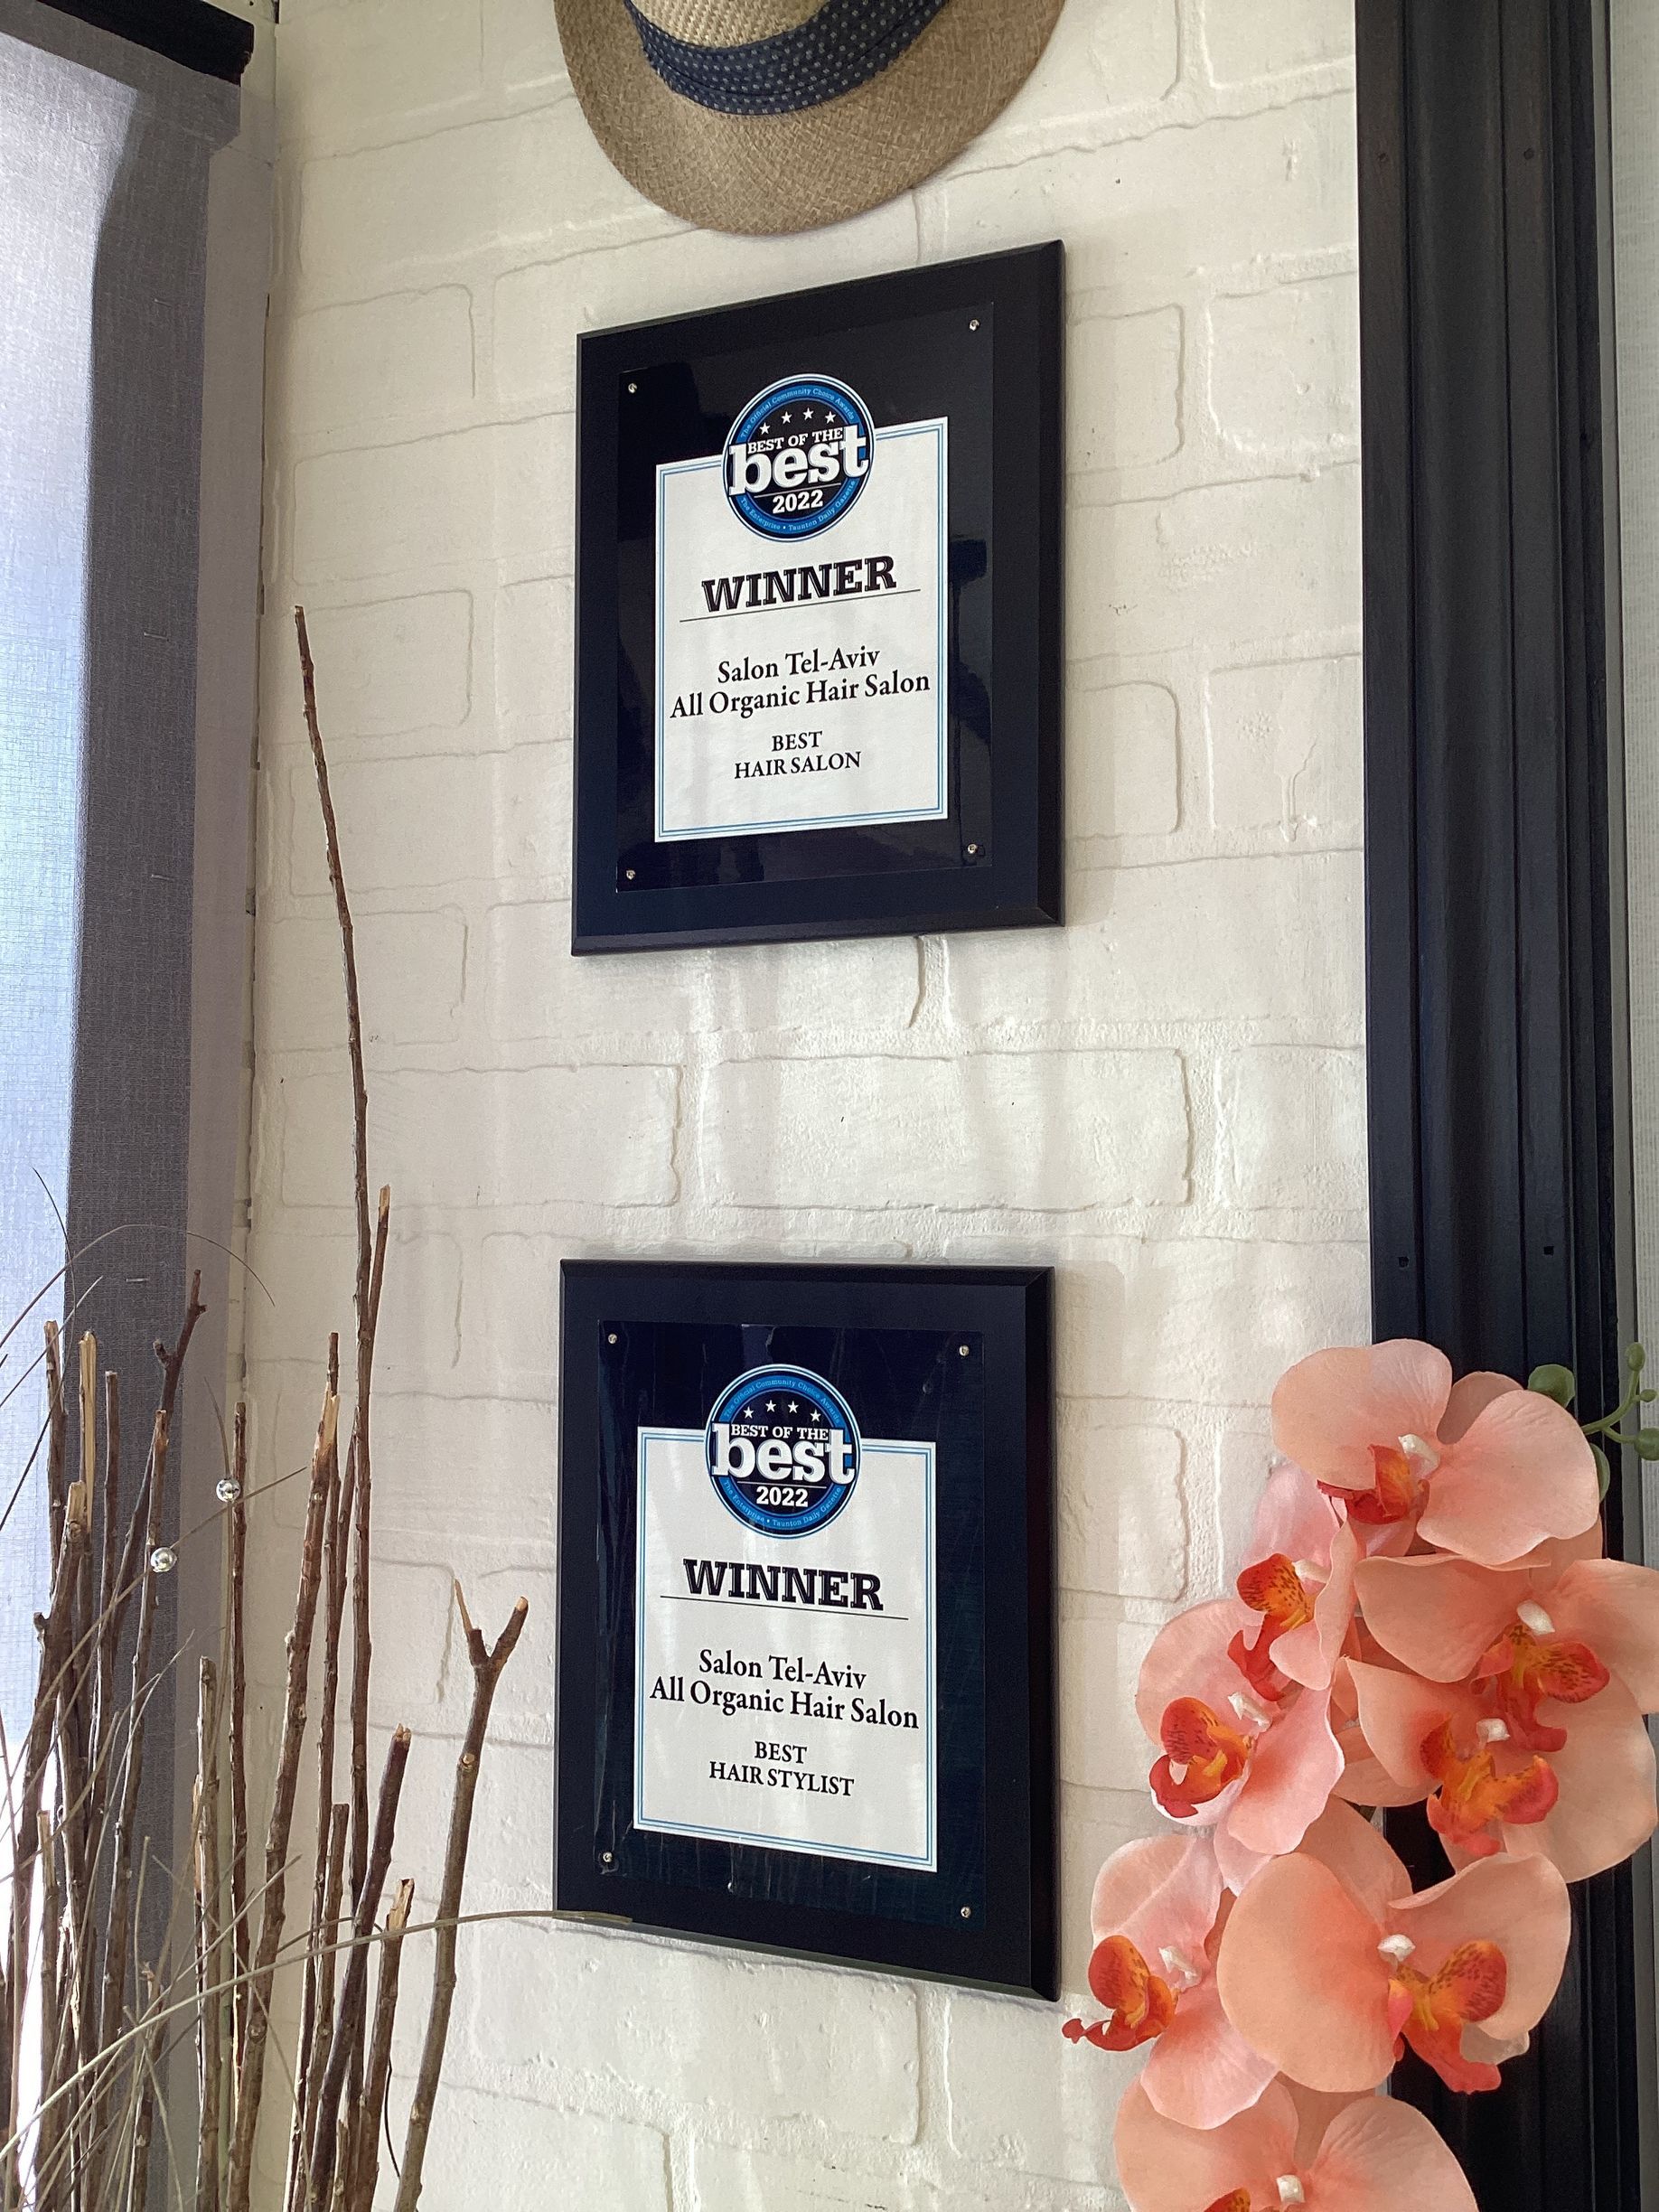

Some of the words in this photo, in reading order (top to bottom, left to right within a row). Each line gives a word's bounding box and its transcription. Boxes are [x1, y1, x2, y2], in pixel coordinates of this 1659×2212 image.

[772, 389, 811, 405] Community
[813, 388, 834, 400] Choice
[835, 398, 855, 420] Awards
[747, 437, 784, 454] BEST
[788, 434, 808, 446] OF
[812, 427, 843, 441] THE
[728, 425, 869, 495] best
[773, 490, 823, 513] 2022
[701, 555, 897, 613] WINNER
[717, 657, 779, 683] Salon
[785, 645, 880, 676] Tel-Aviv
[670, 692, 703, 718] All
[709, 685, 801, 719] Organic
[806, 679, 859, 704] Hair
[864, 670, 931, 697] Salon
[772, 730, 823, 752] BEST
[734, 758, 788, 779] HAIR
[791, 751, 861, 775] SALON
[756, 1379, 795, 1390] Community
[798, 1382, 820, 1399] Choice
[820, 1398, 839, 1424] Awards
[731, 1424, 768, 1438] BEST
[773, 1426, 792, 1439] OF
[797, 1428, 829, 1440] THE
[712, 1422, 855, 1485] best
[756, 1486, 808, 1507] 2022
[683, 1558, 884, 1611] WINNER
[699, 1649, 763, 1678] Salon
[769, 1655, 867, 1689] Tel-Aviv
[650, 1676, 684, 1701] All
[690, 1680, 784, 1716] Organic
[790, 1691, 845, 1720] Hair
[851, 1697, 919, 1729] Salon
[755, 1741, 807, 1764] BEST
[709, 1761, 764, 1785] HAIR
[767, 1769, 854, 1796] STYLIST
